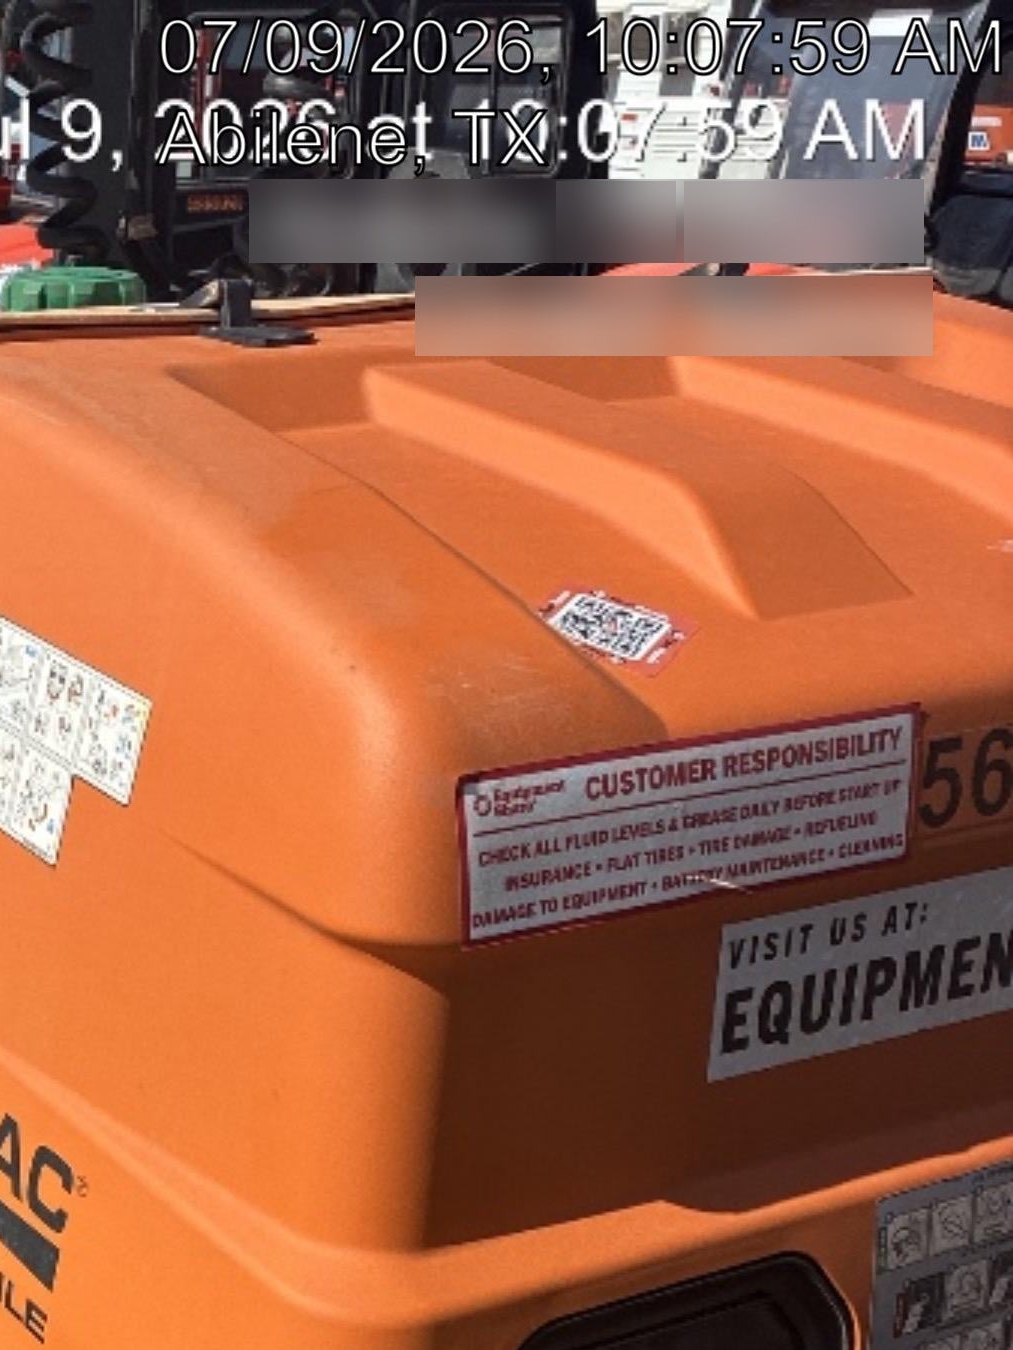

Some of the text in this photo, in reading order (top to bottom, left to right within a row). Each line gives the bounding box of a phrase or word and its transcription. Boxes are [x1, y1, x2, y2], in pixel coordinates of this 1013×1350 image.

[585, 725, 903, 801] CUSTOMER RESPONSIBILITY
[918, 728, 1013, 827] 56
[478, 844, 531, 867] CHECK
[535, 837, 561, 858] ALL
[565, 829, 609, 850] FLUID
[612, 819, 665, 842] LEVELS
[740, 800, 779, 820] DAILY
[784, 790, 837, 811] BEFORE
[839, 782, 880, 802] START
[505, 861, 591, 892] INSURANCE
[607, 852, 639, 873] FLAT
[644, 842, 685, 864] TIRES
[698, 836, 729, 856] TIRE
[734, 826, 792, 850] DAMAGE
[472, 904, 537, 928] DAMAGE
[540, 898, 558, 914] TO
[562, 881, 648, 910] EQUIPMENT
[726, 847, 826, 879] MAINTENANCE
[839, 834, 904, 858] CLEANING
[729, 902, 928, 969] VISIT US AT:
